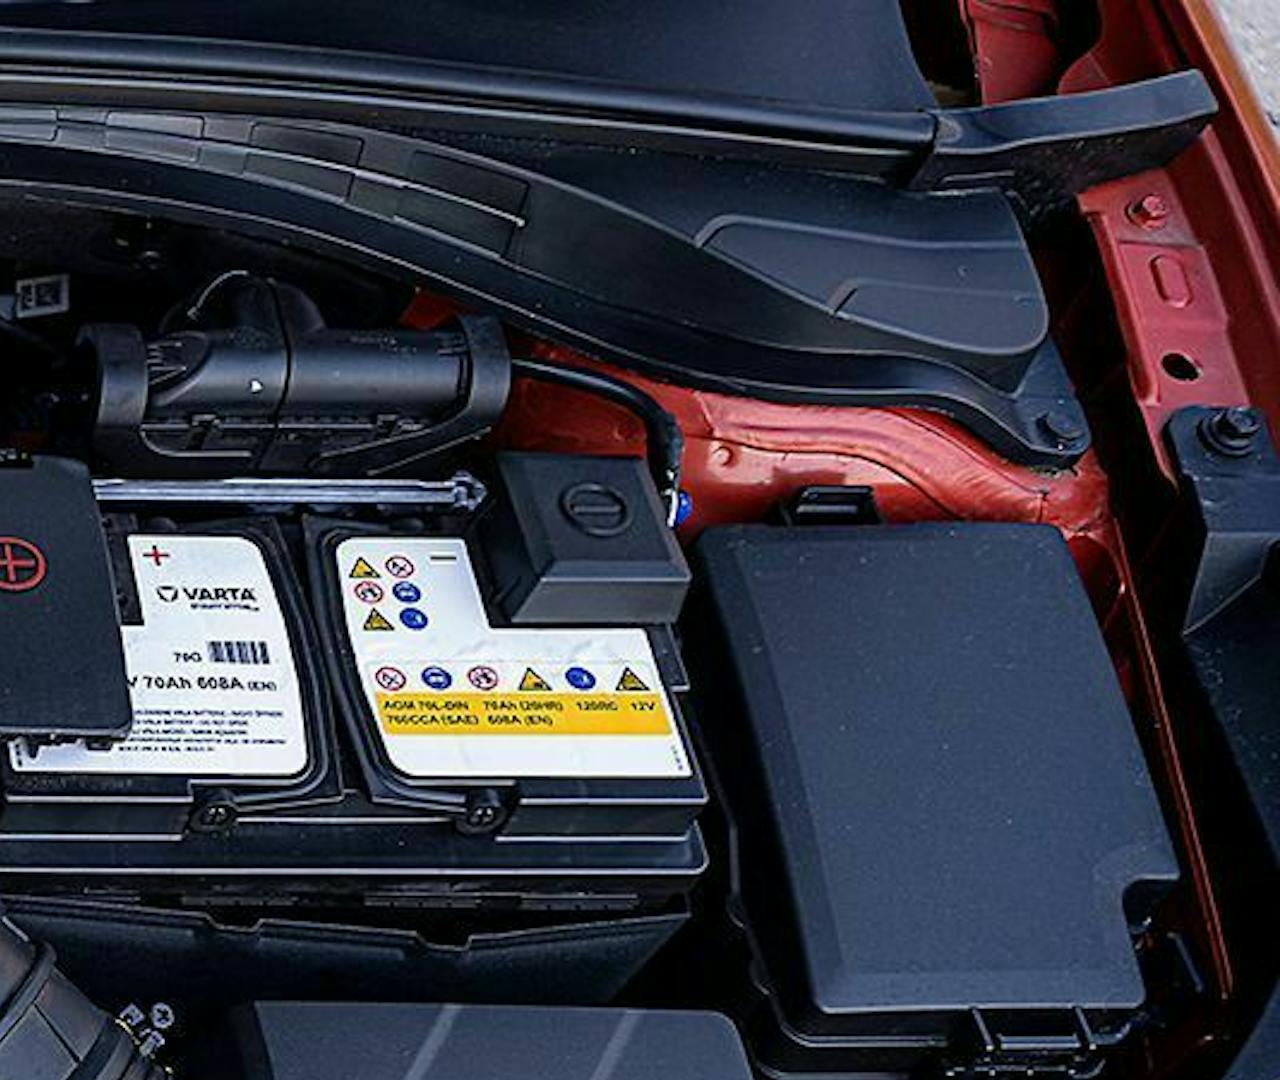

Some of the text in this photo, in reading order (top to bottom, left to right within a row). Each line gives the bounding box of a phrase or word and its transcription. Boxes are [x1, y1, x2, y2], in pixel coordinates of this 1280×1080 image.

[183, 587, 256, 601] VARTA
[143, 677, 191, 689] 70Ah
[197, 677, 245, 690] 608A
